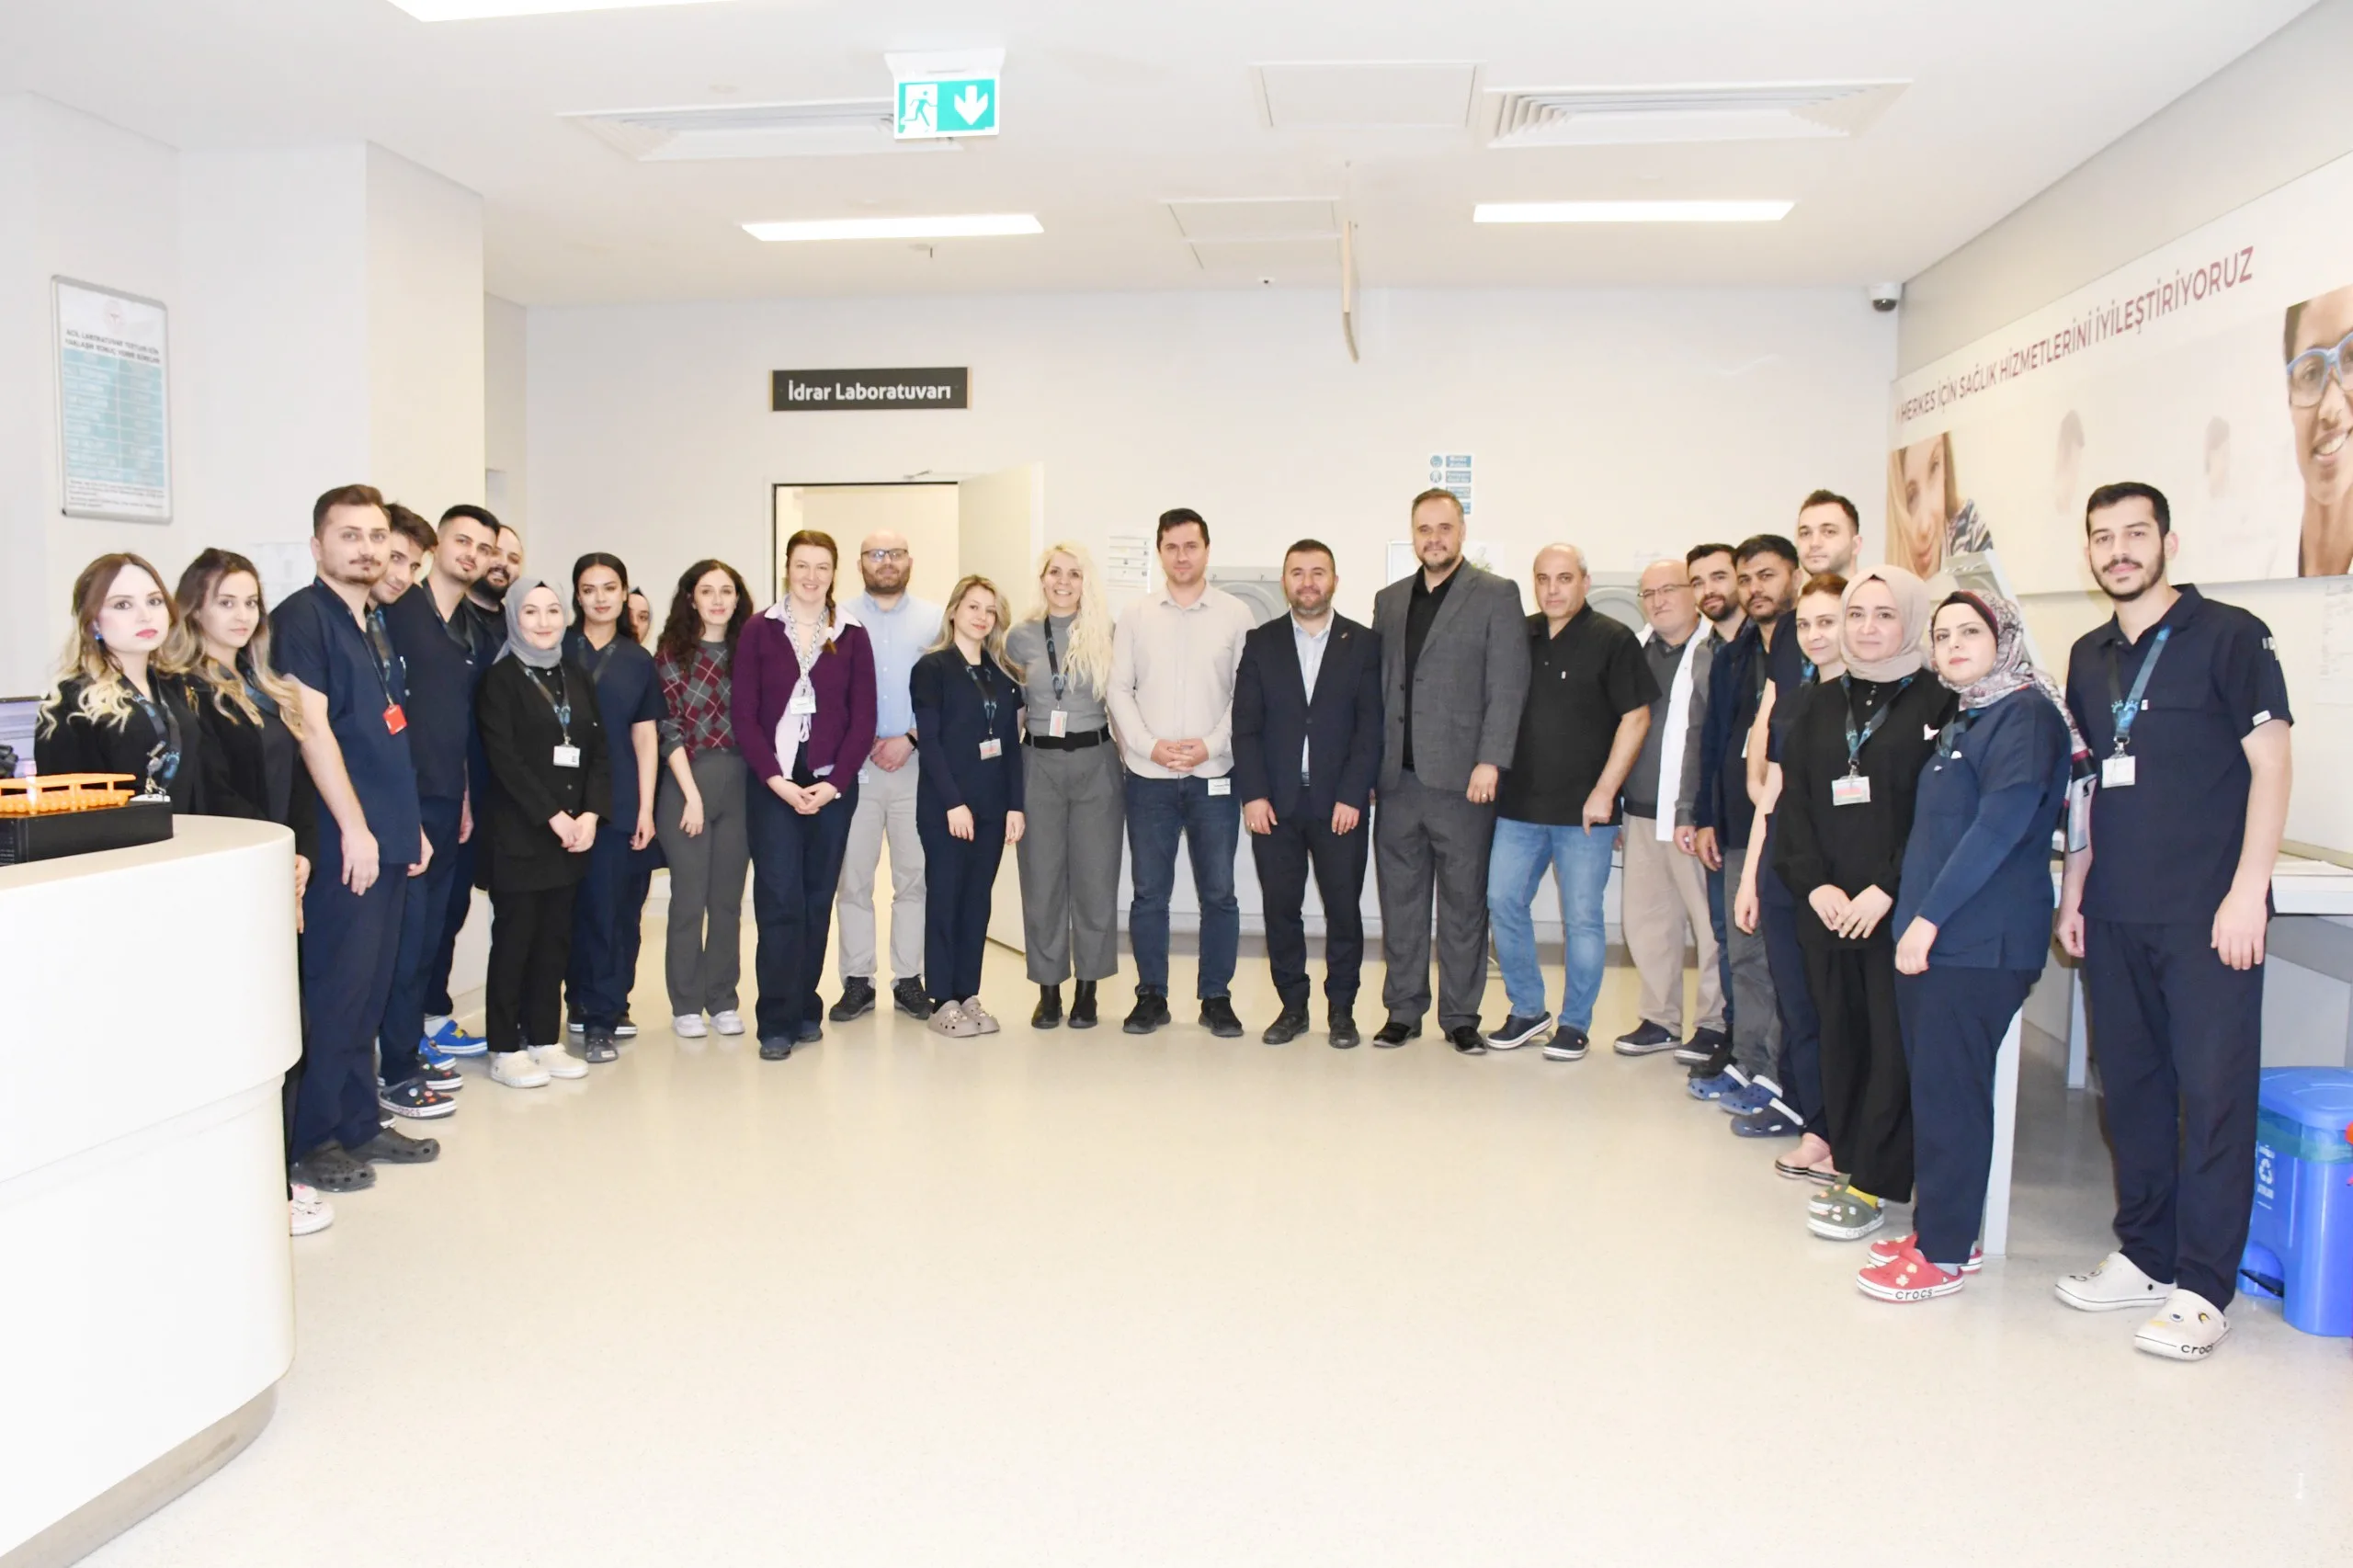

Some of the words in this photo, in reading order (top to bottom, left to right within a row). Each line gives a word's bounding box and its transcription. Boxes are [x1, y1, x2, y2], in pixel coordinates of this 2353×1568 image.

[1901, 389, 1936, 425] HERKES
[1938, 376, 1958, 414] İÇİN
[1959, 361, 1997, 398] SAĞLIK
[1999, 310, 2092, 382] HİZMETLERİNİ
[2096, 245, 2254, 343] İYİLEŞTİRİYORUZ
[788, 379, 832, 401] İdrar
[835, 382, 951, 401] Laboratuvarı
[1895, 1288, 1933, 1301] crocs
